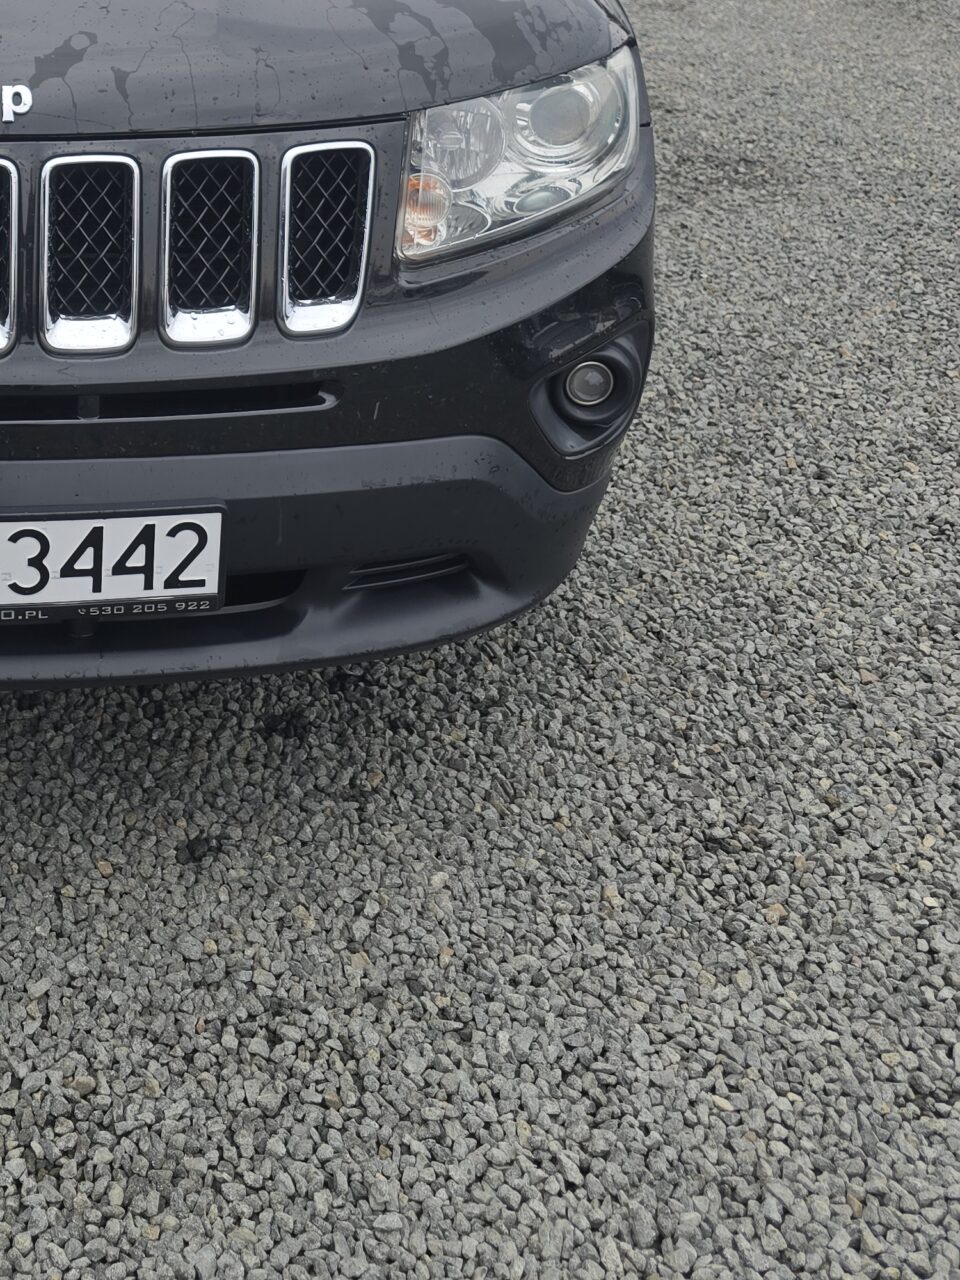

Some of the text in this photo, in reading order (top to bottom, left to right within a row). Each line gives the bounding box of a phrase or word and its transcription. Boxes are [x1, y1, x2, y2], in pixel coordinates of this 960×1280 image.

[90, 600, 210, 615] 530 205 922
